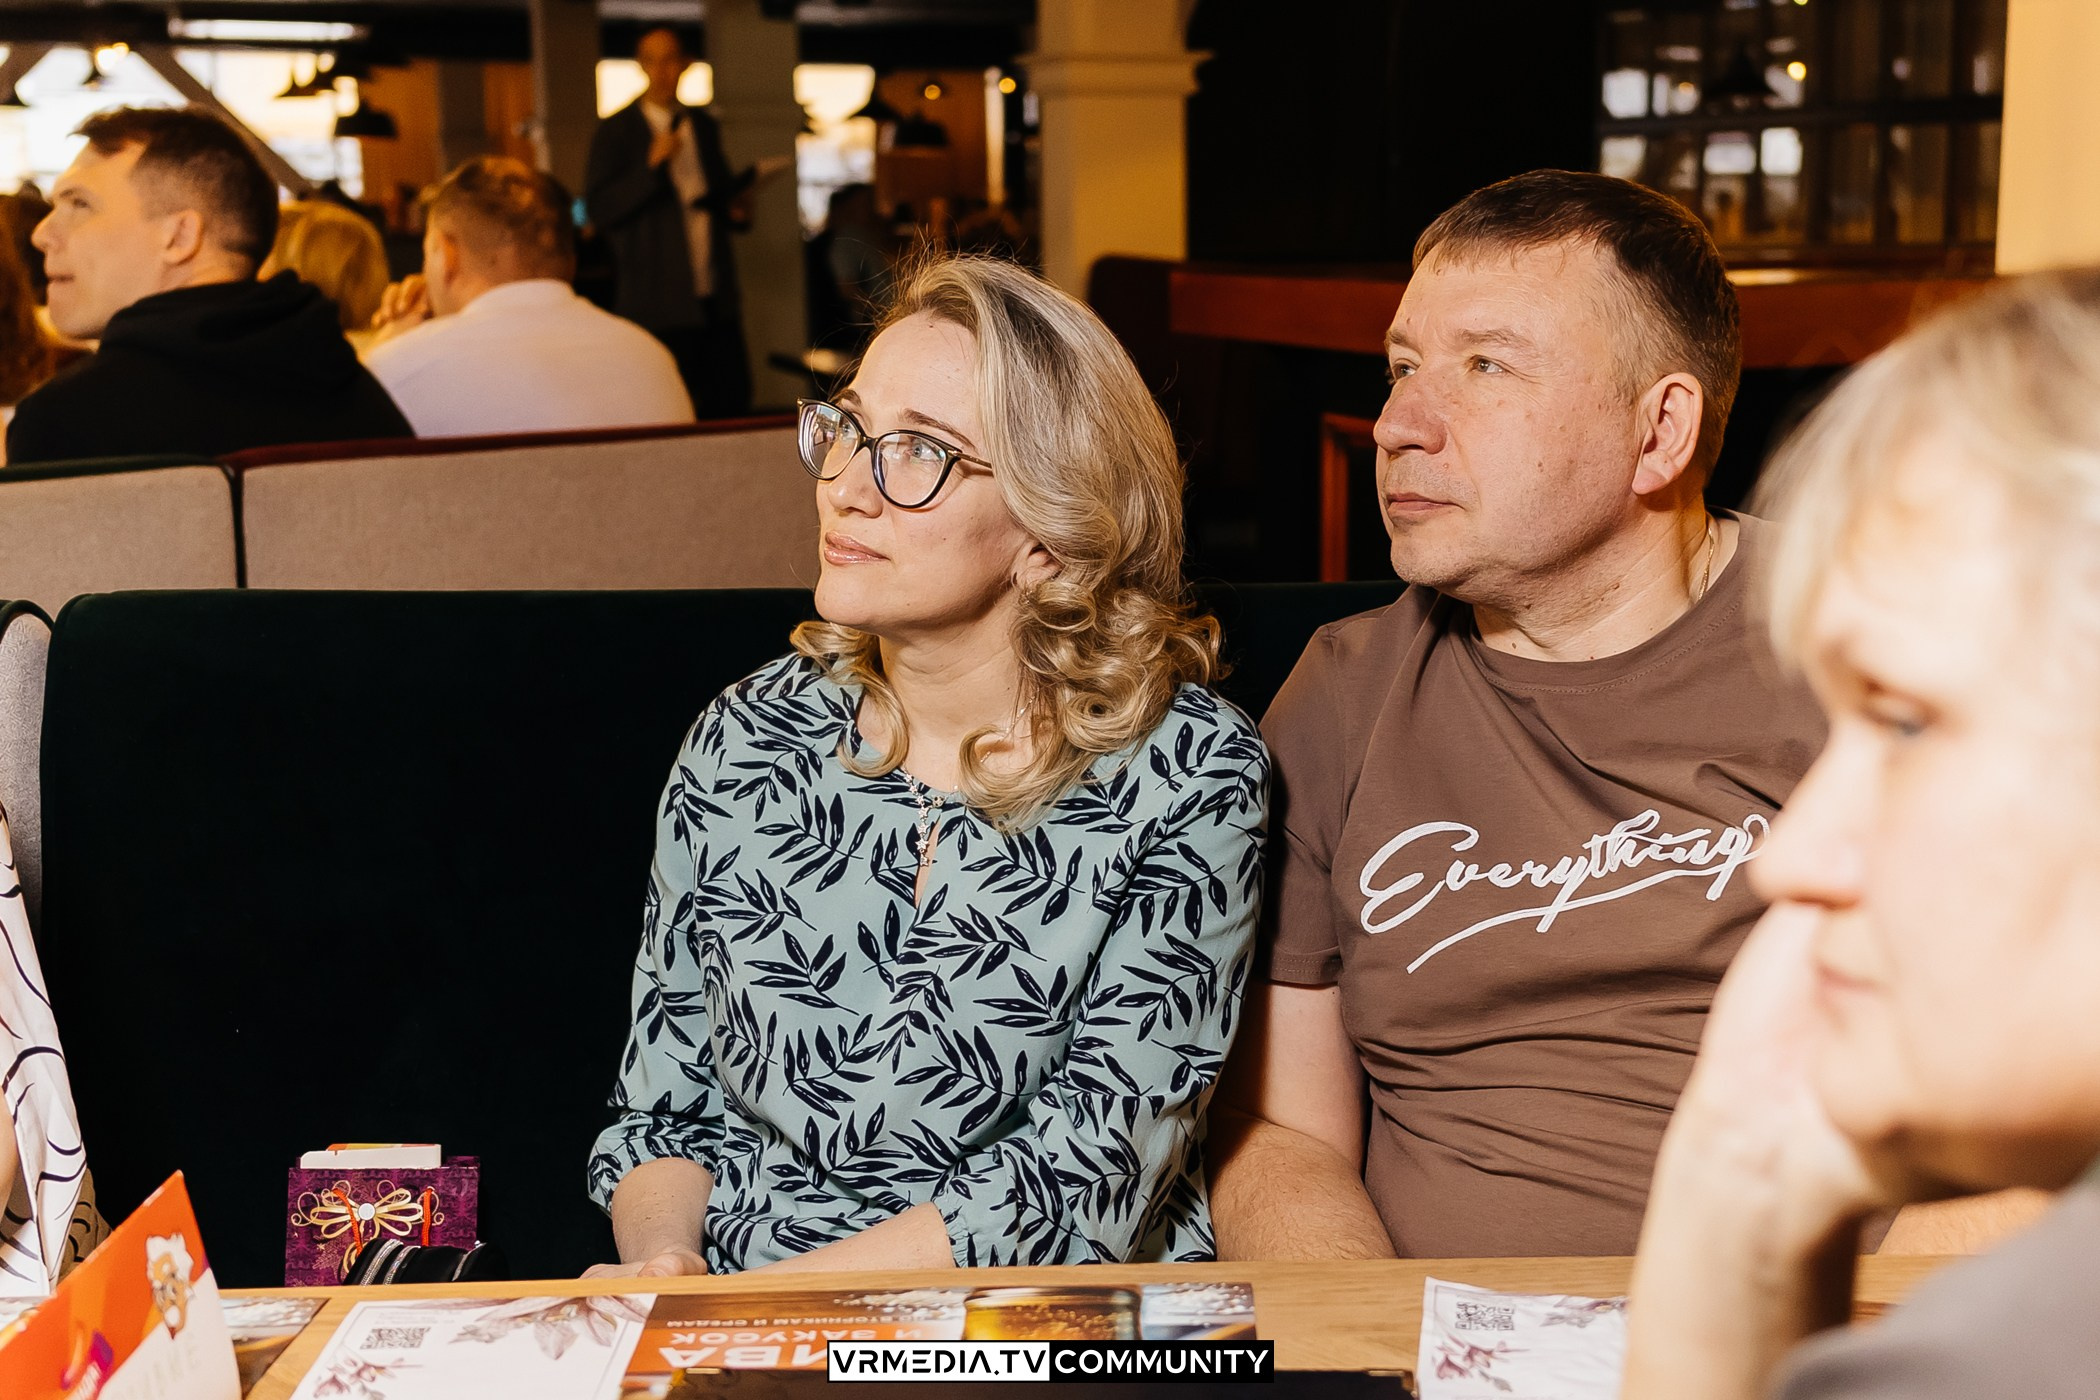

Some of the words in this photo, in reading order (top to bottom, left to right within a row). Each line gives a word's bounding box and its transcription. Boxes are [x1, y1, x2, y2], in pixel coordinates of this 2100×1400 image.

[1360, 809, 1771, 934] Everything
[667, 1319, 747, 1328] СРЕДАМ
[669, 1329, 877, 1344] ЗАКУСОК
[658, 1345, 829, 1367] ИВА
